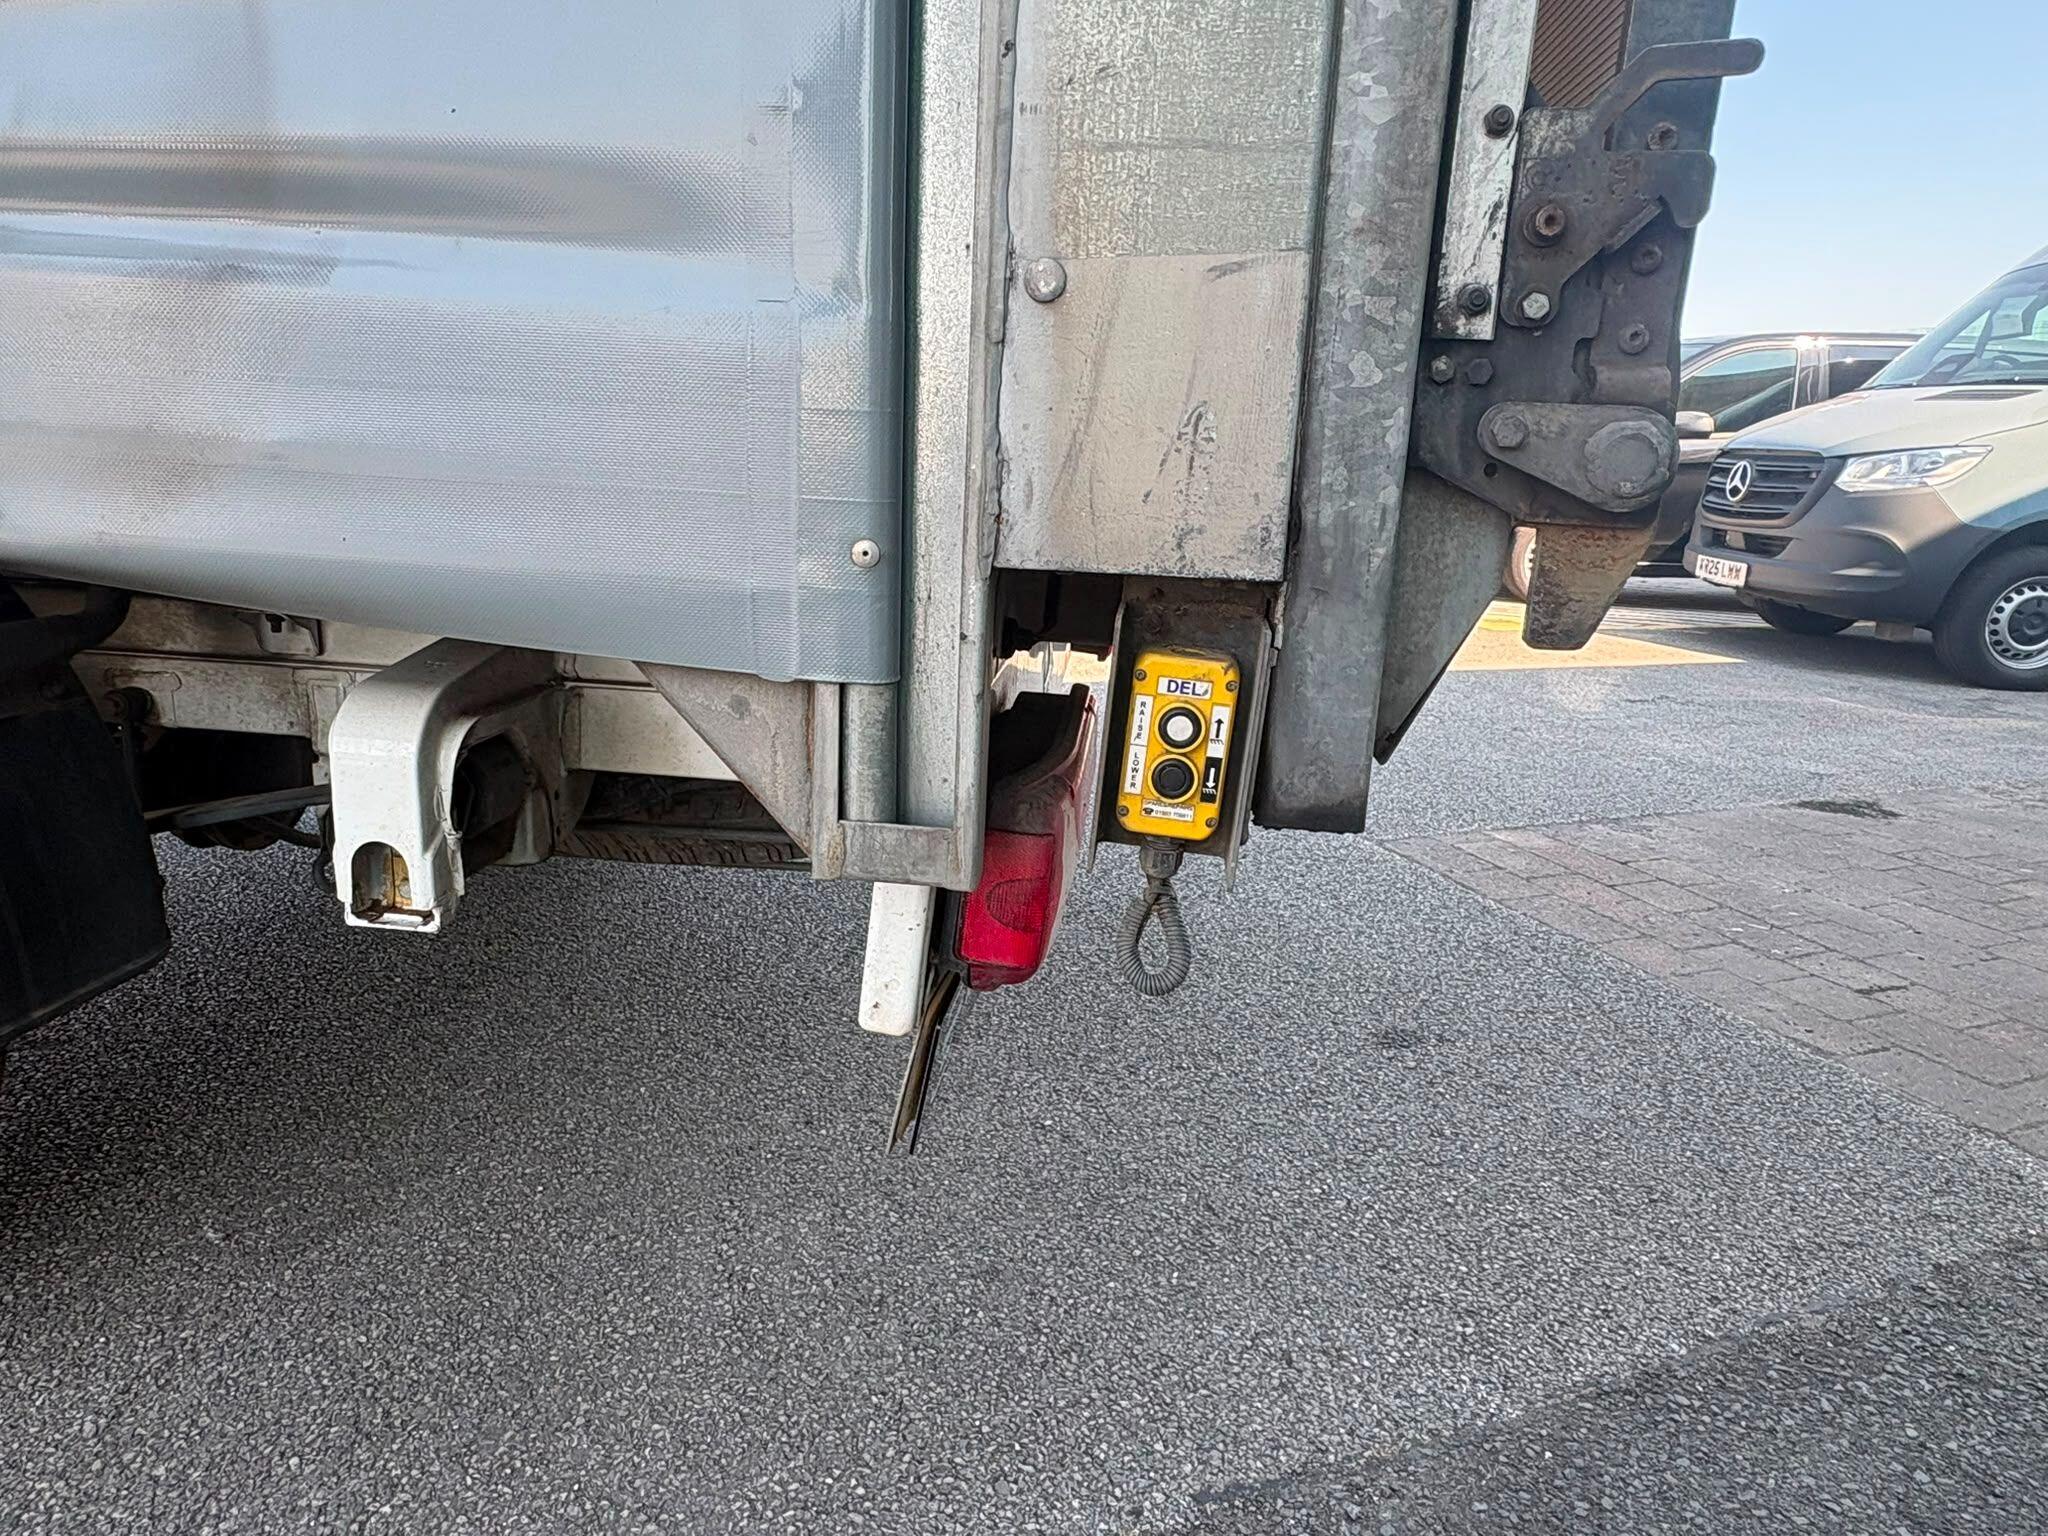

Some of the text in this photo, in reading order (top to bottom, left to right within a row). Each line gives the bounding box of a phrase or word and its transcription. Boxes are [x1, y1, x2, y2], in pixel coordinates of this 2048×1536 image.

[1167, 679, 1202, 697] DEL
[1134, 701, 1147, 740] RAISE
[1129, 752, 1140, 789] LOWER
